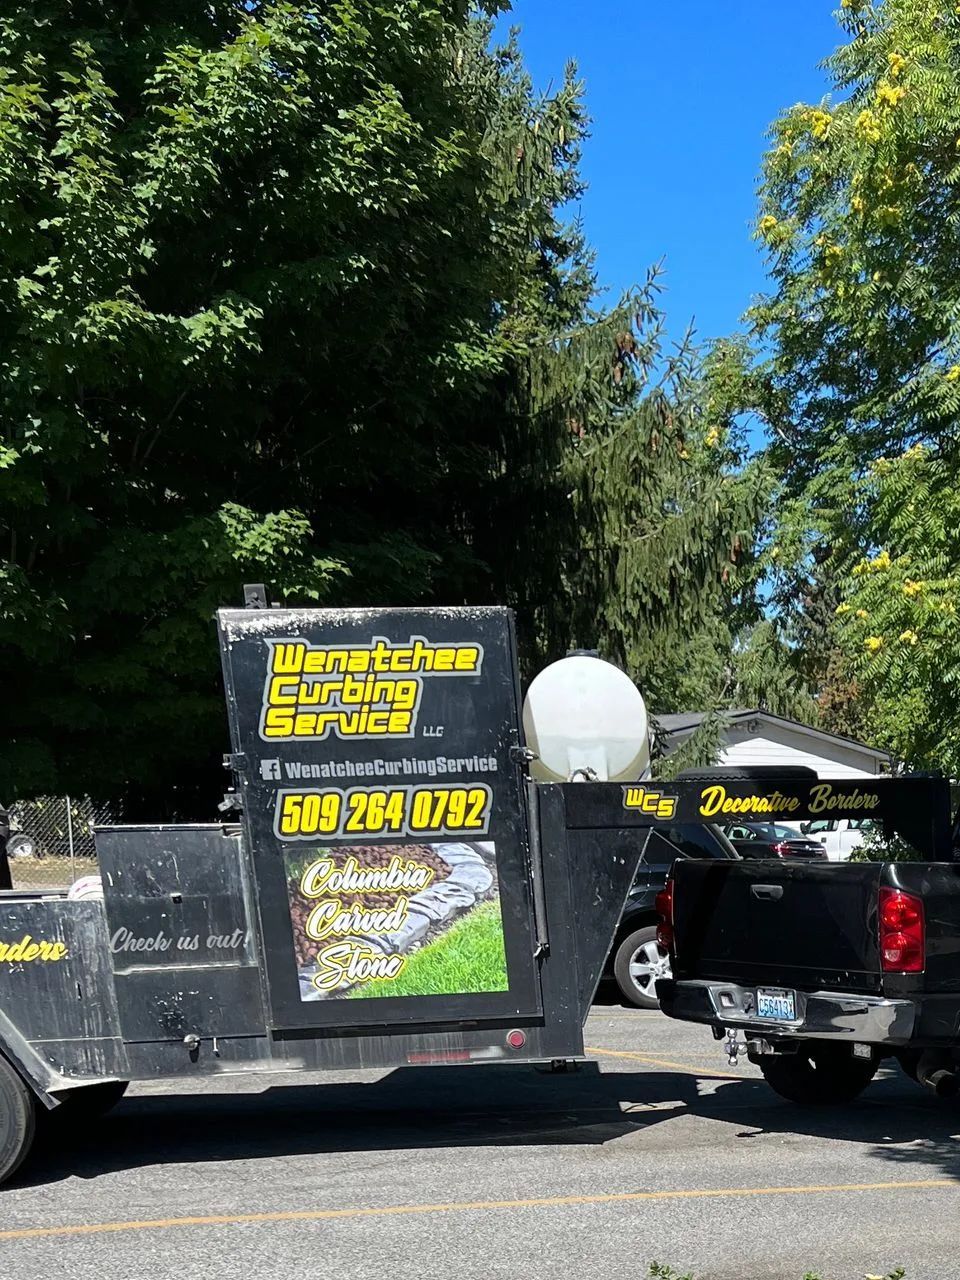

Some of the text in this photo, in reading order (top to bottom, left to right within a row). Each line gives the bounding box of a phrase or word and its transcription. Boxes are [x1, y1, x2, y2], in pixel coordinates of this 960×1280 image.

[271, 640, 480, 675] Wenatchee
[267, 673, 419, 711] Curbing
[263, 704, 445, 737] Service LLC
[284, 756, 498, 780] WenatcheeCurbingService
[280, 788, 487, 834] 509 264 0792
[626, 787, 676, 818] WCS
[700, 783, 881, 817] Decorative Borders
[301, 855, 434, 898] Columbia
[306, 896, 408, 941] Carved
[110, 926, 174, 953] Check
[176, 934, 200, 950] us
[313, 940, 405, 992] Stone
